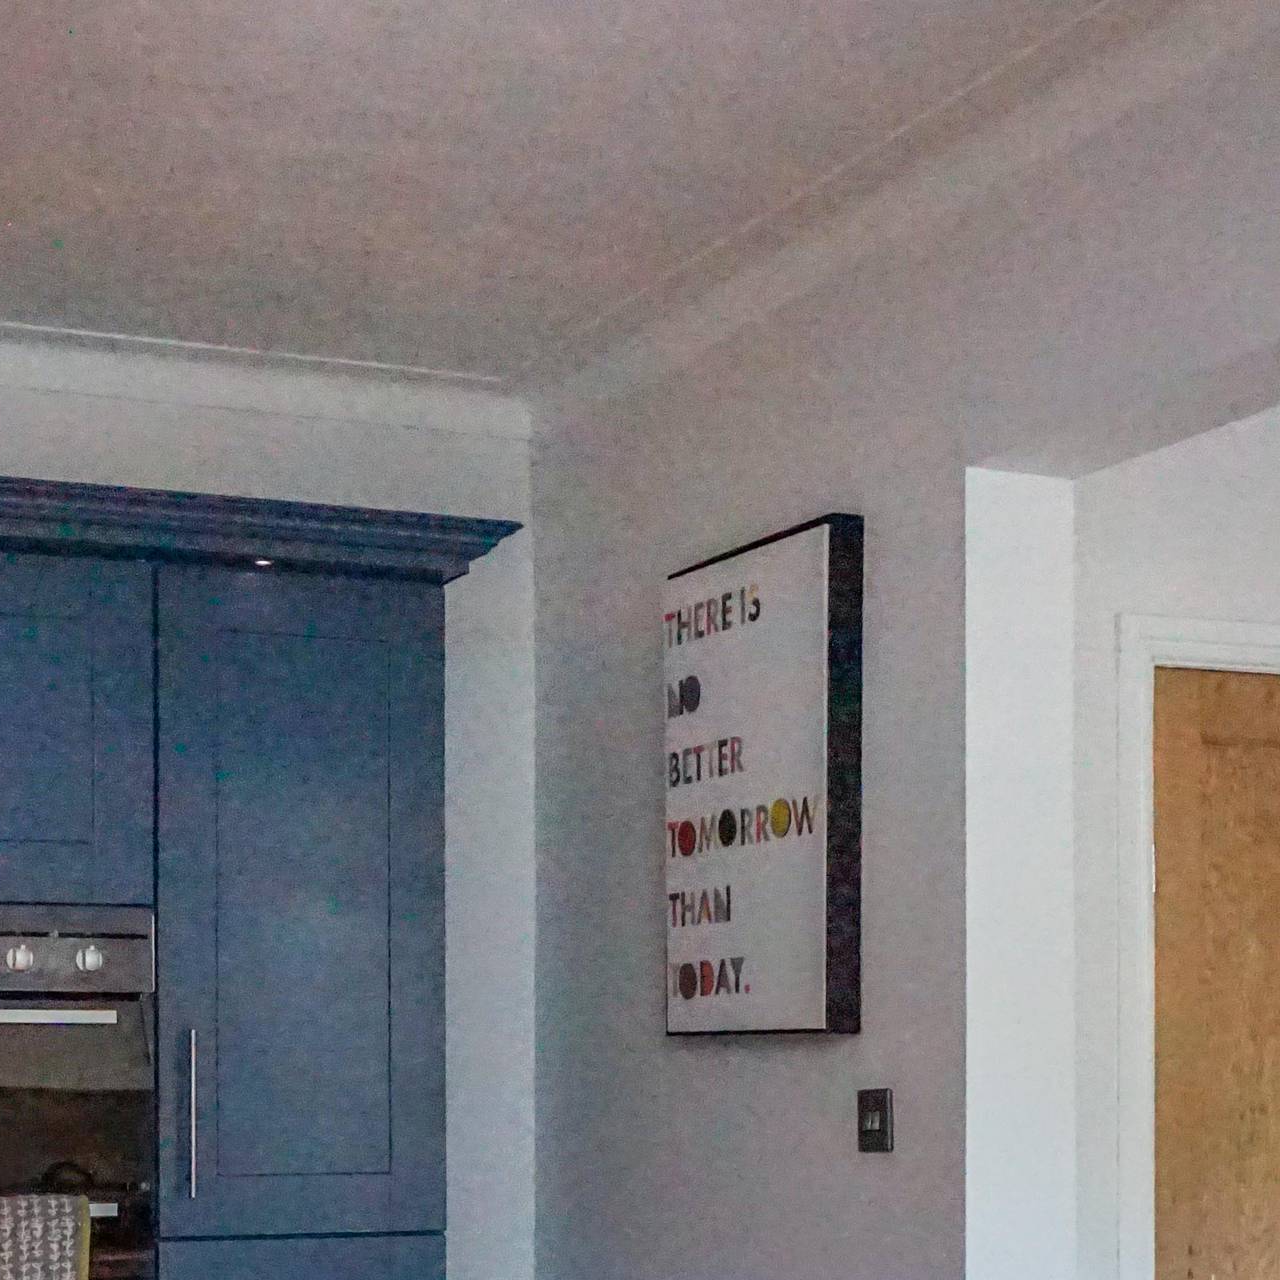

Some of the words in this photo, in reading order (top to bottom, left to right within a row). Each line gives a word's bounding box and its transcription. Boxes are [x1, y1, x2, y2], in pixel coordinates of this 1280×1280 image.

[663, 592, 732, 648] THERE
[740, 584, 761, 625] IS
[667, 675, 701, 719] NO
[669, 736, 744, 787] BETTER
[667, 796, 819, 857] TOMORROW
[669, 885, 731, 927] THAN
[670, 957, 751, 1000] TODAY.
